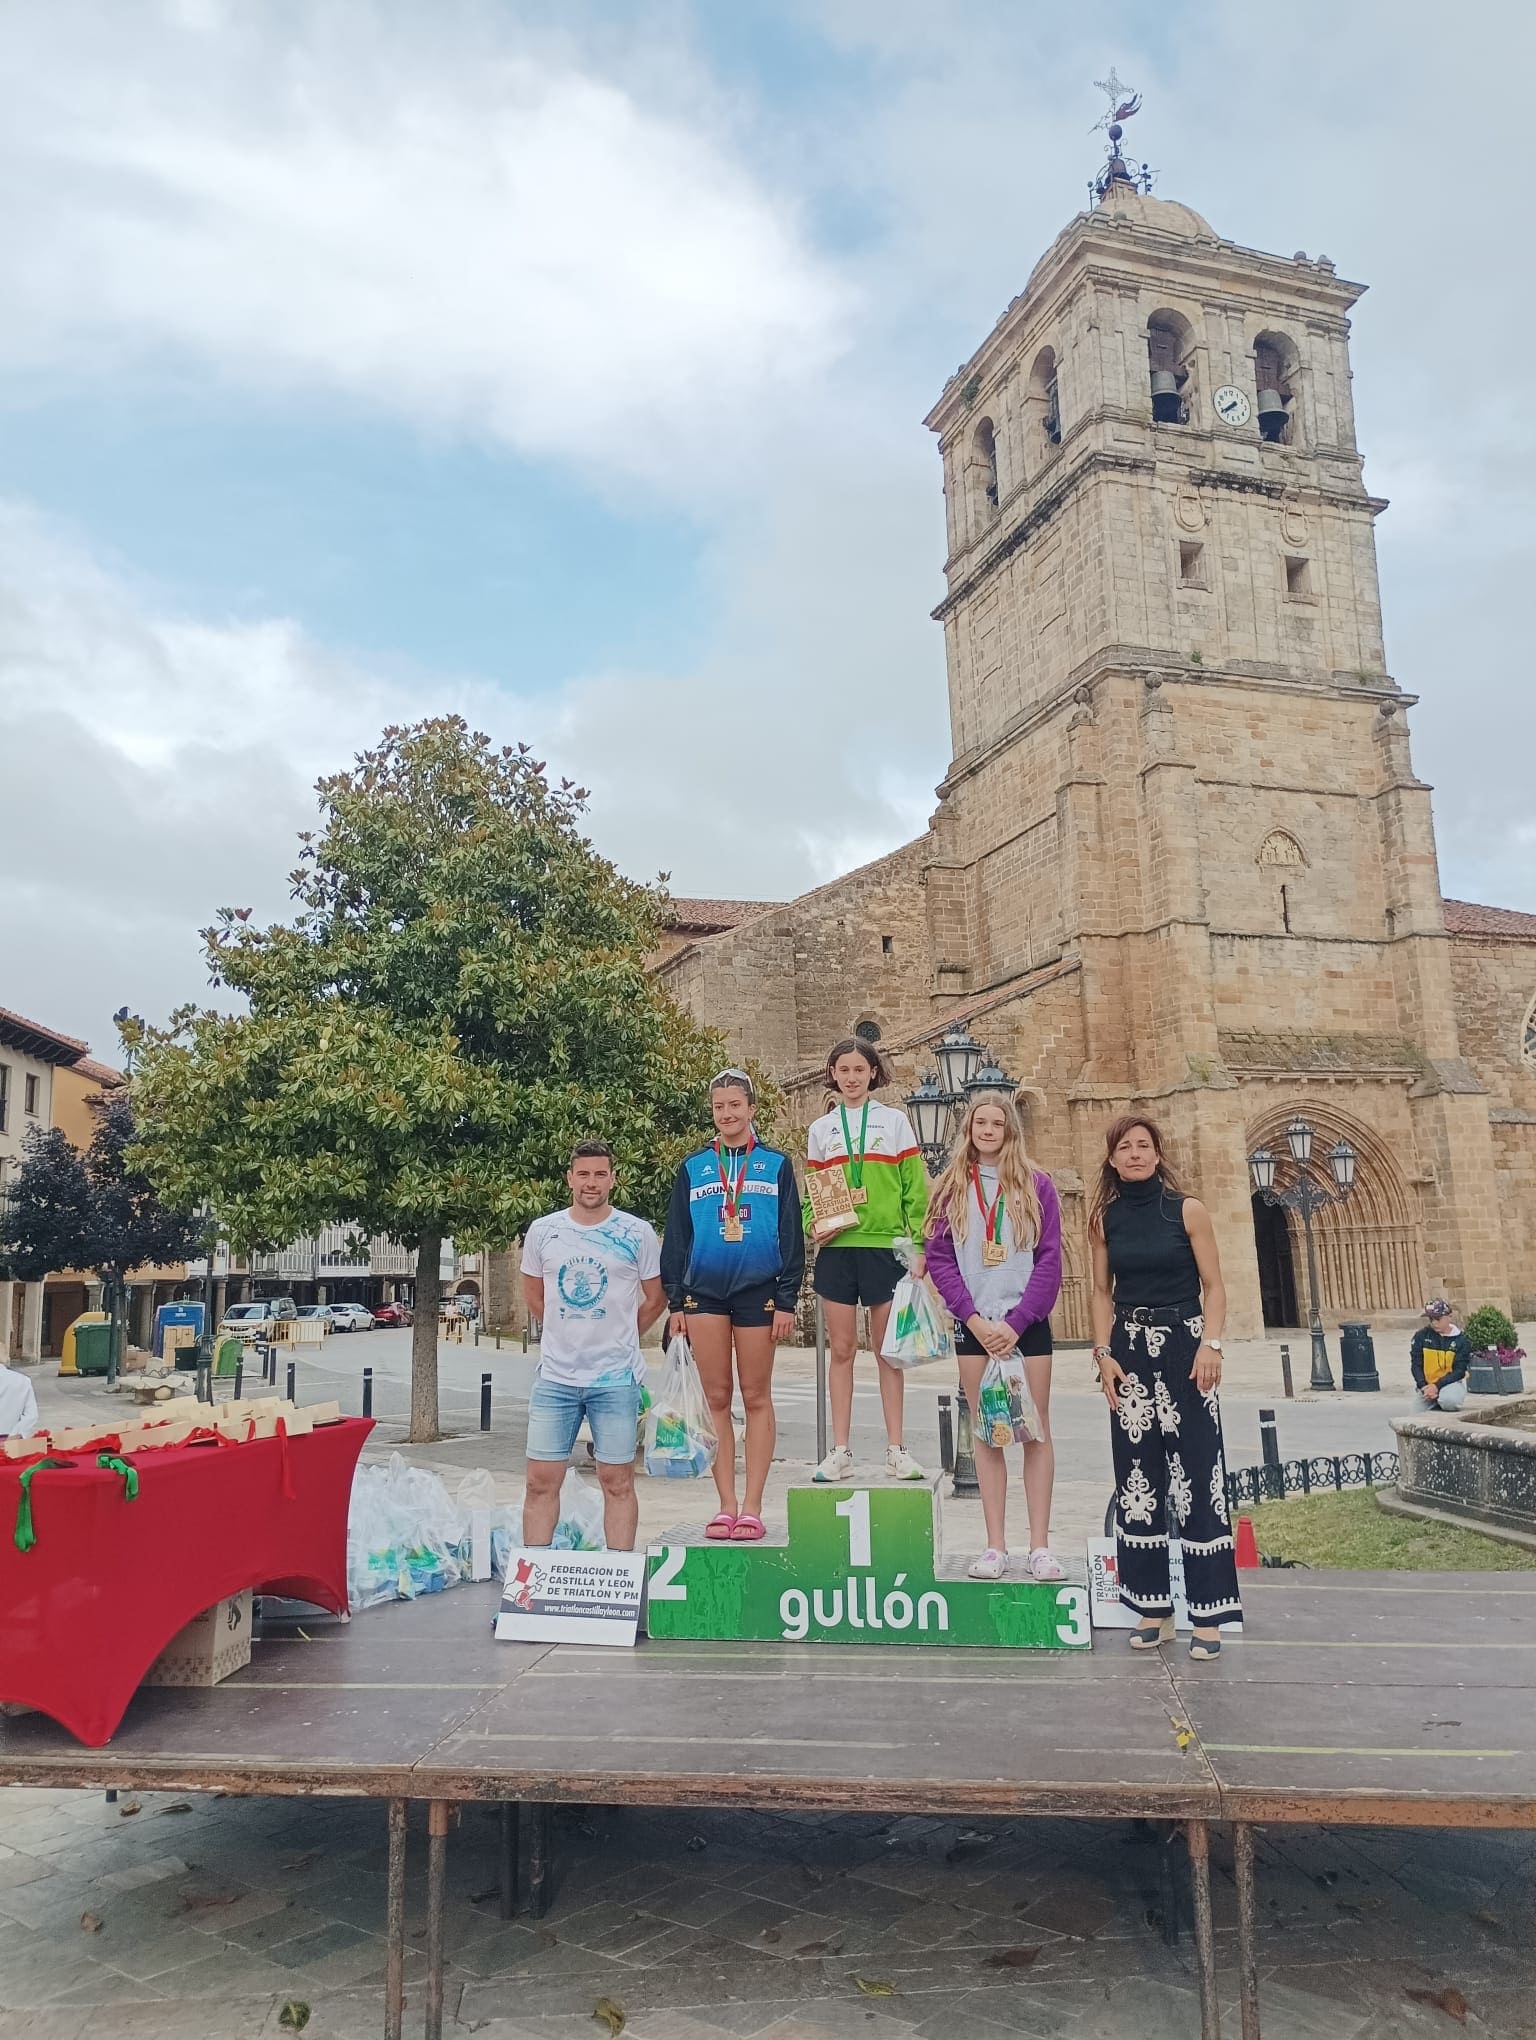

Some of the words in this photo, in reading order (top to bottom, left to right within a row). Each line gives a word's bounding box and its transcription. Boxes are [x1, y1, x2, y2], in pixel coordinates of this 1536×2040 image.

[696, 1184, 734, 1199] LAGUNA
[823, 1197, 849, 1209] CASTILLA
[832, 1202, 851, 1213] LEON
[836, 1490, 871, 1567] 1
[550, 1565, 613, 1576] FEDERACION
[615, 1569, 630, 1577] DE
[648, 1546, 687, 1600] 2
[1094, 1554, 1105, 1602] TRIATLON
[549, 1576, 595, 1586] CASTILLA
[598, 1579, 605, 1587] Y
[607, 1579, 635, 1588] LEON
[547, 1587, 560, 1595] DE
[563, 1588, 611, 1598] TRIATLON
[614, 1591, 621, 1599] Y
[623, 1591, 639, 1600] PM
[544, 1604, 635, 1617] www.triatloncastillayleon.com
[779, 1573, 949, 1639] gullón
[1056, 1586, 1091, 1645] 3
